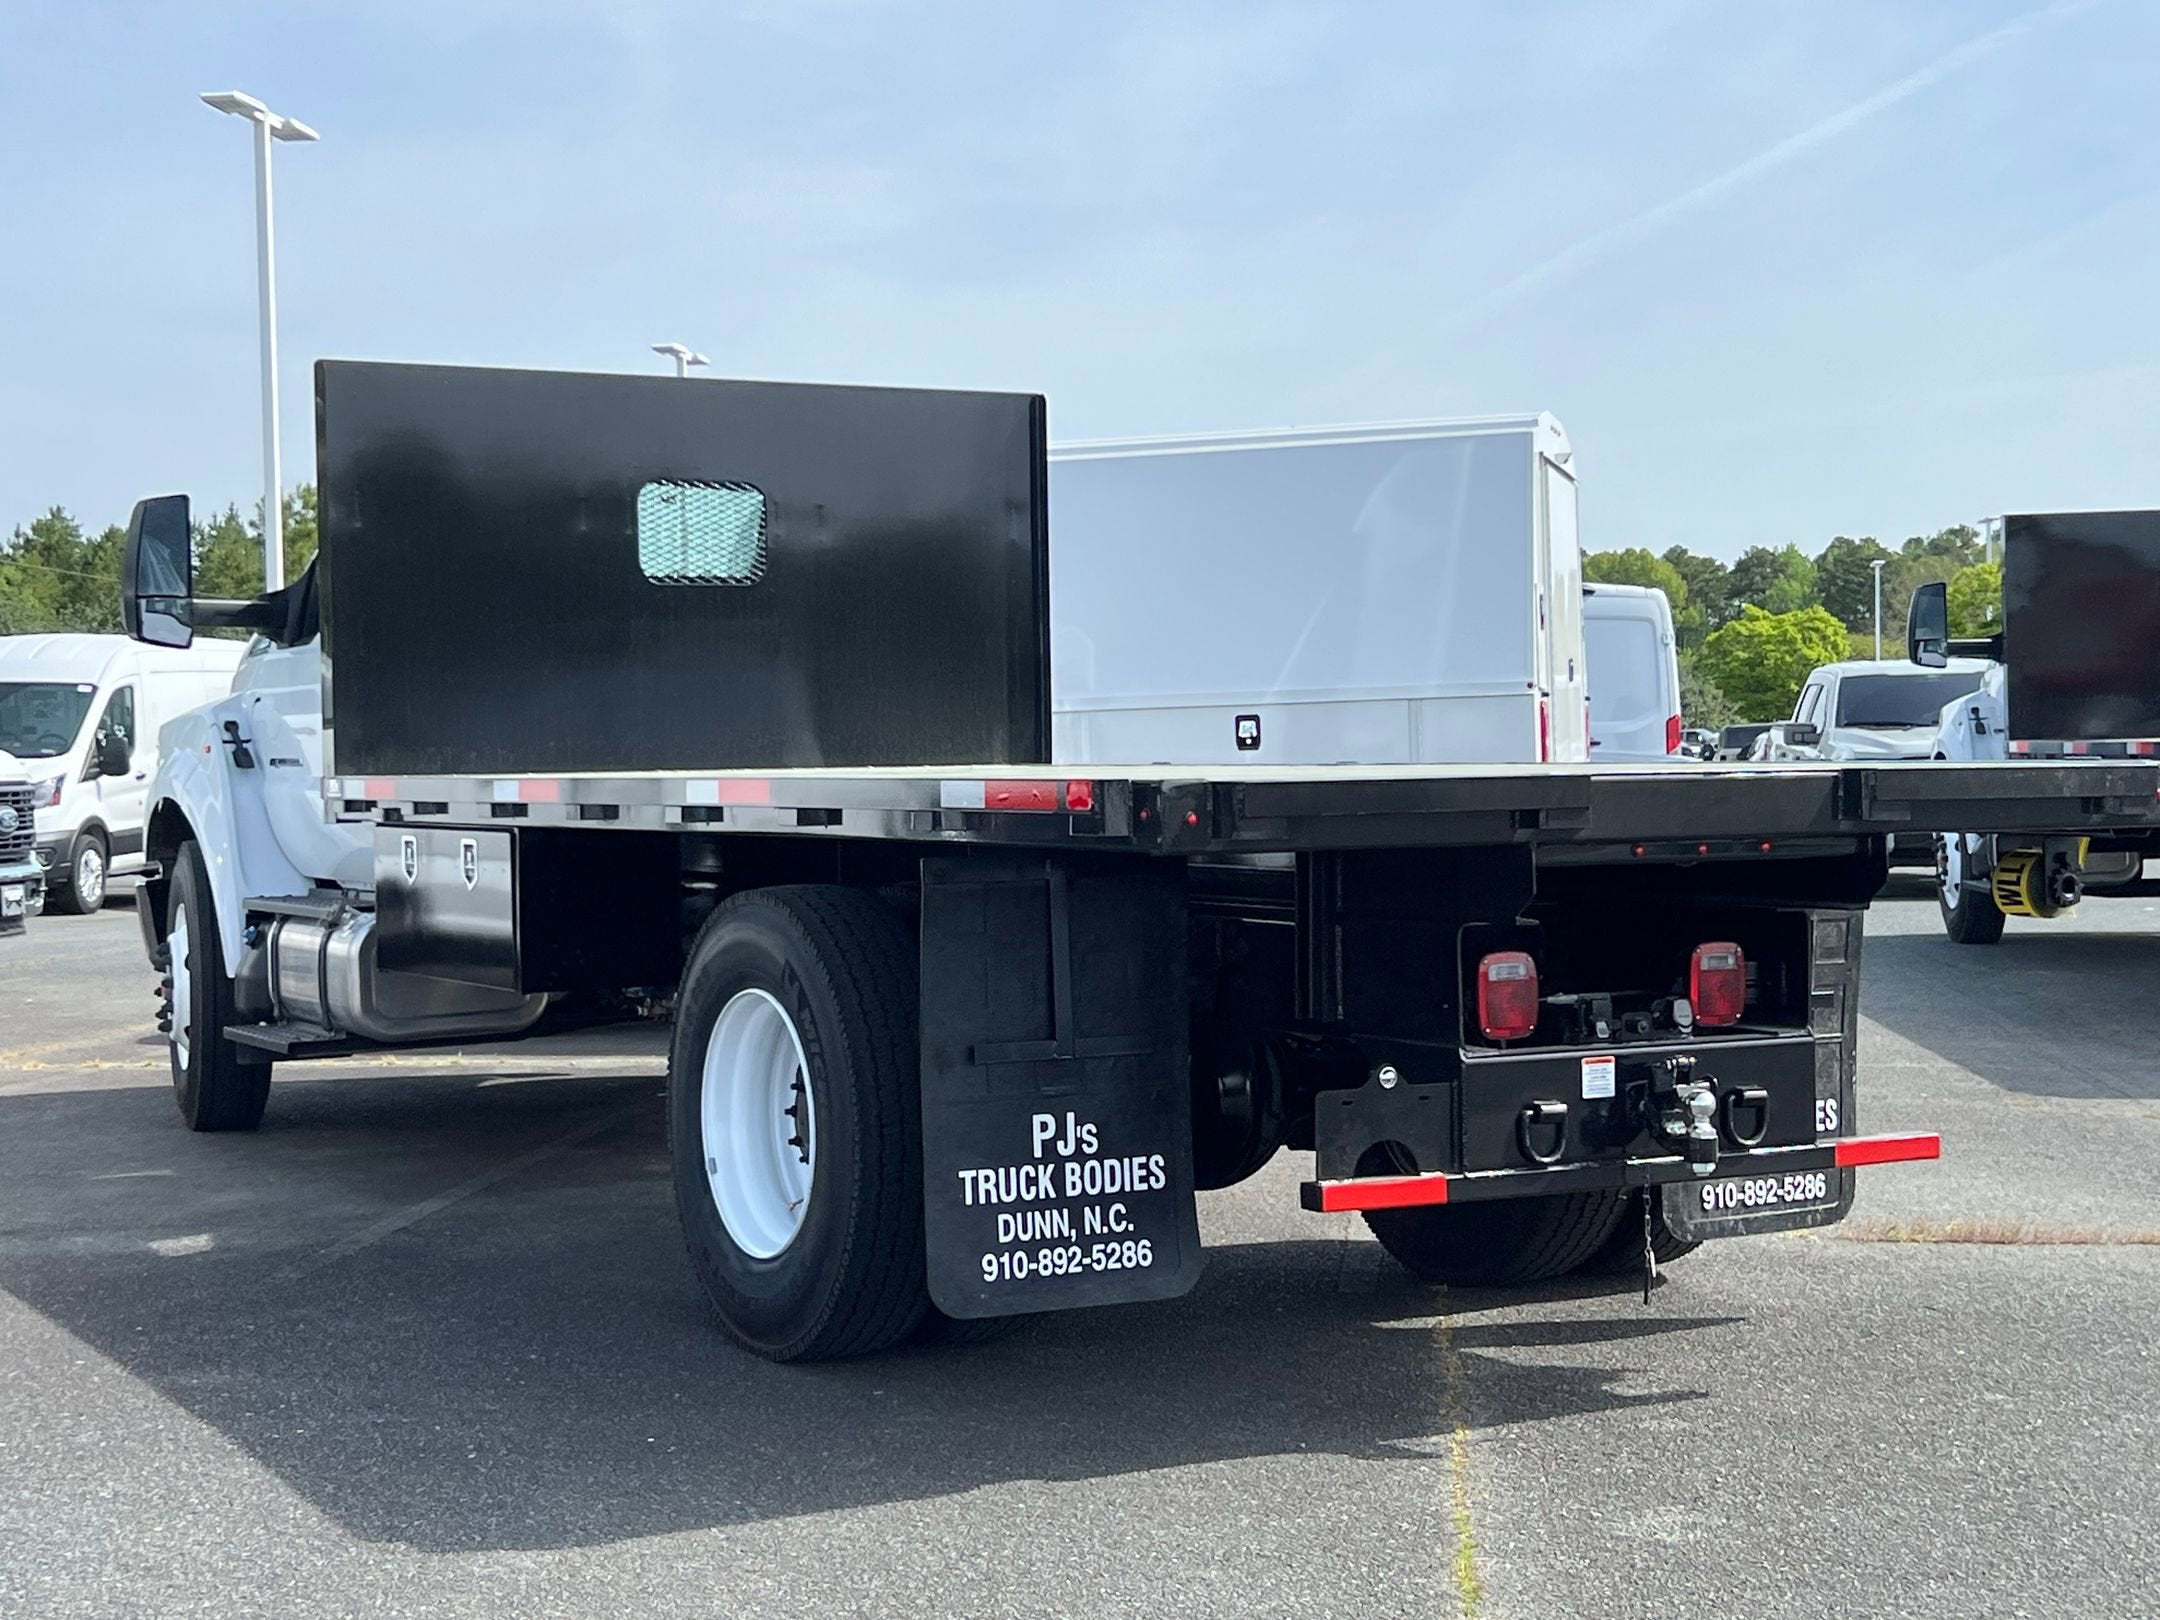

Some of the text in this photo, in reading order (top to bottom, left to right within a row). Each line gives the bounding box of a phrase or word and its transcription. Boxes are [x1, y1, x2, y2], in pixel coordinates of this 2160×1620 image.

[958, 1154, 1166, 1206] TRUCK BODIES
[1701, 1172, 1827, 1211] 910-892-5286
[997, 1202, 1135, 1244] DUNN, N.C.
[981, 1239, 1153, 1282] 910-892-5286
